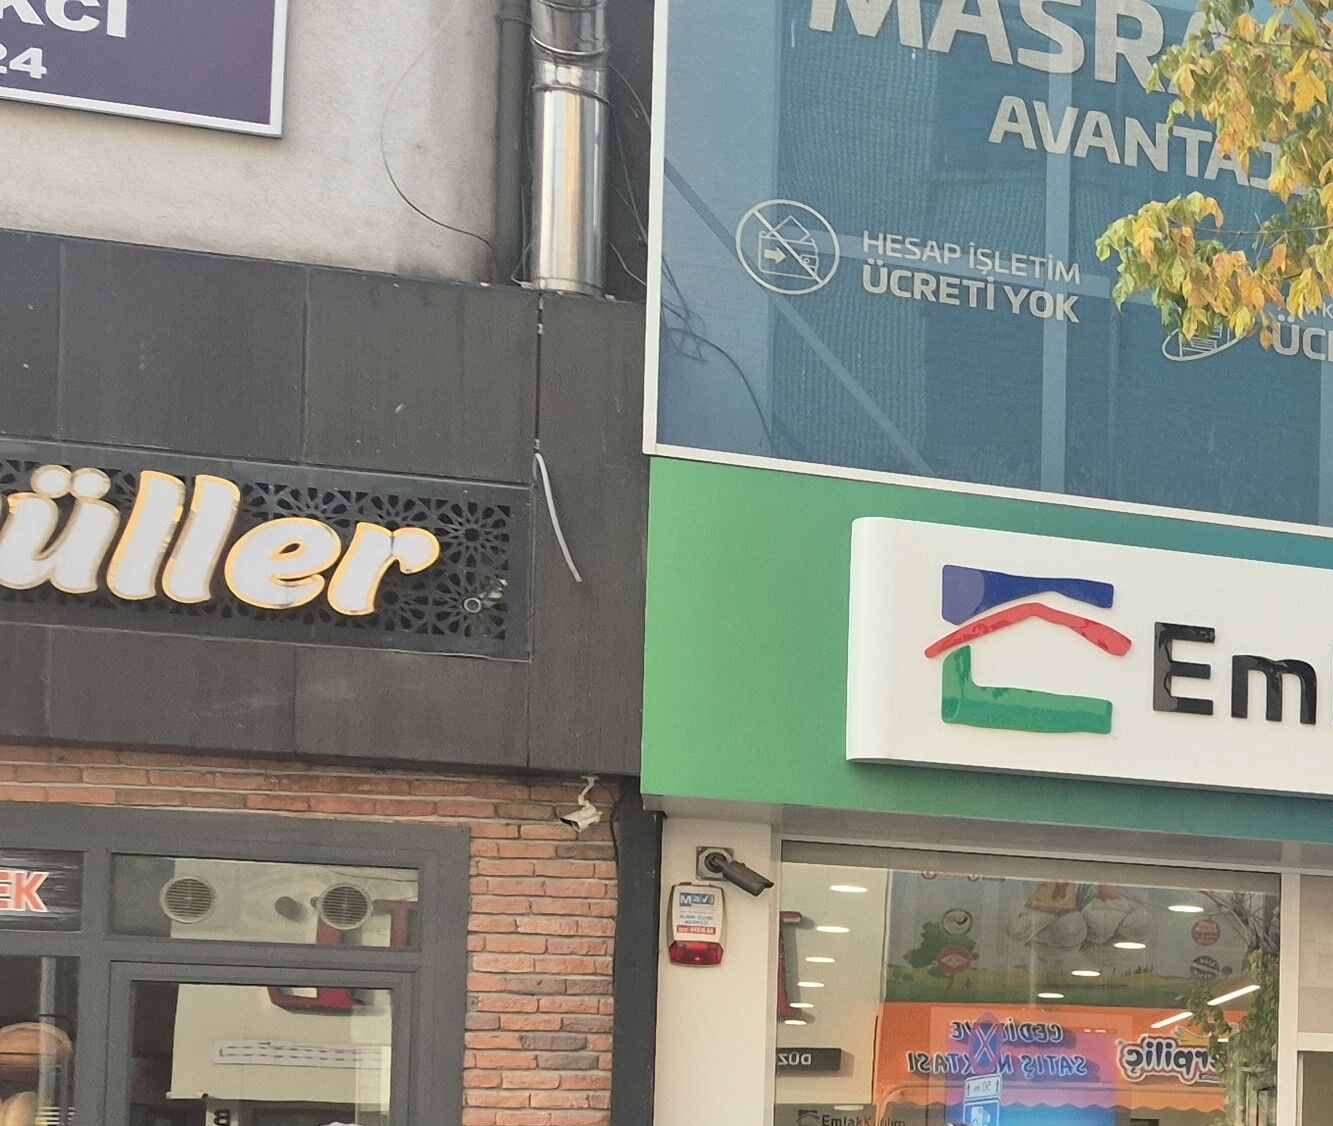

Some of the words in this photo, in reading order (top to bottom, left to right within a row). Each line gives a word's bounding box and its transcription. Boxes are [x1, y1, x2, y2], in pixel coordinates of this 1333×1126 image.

[0, 43, 47, 79] 4
[862, 230, 960, 265] HESAP
[969, 244, 1080, 285] İŞLETİM
[862, 257, 995, 311] ÜCRETİ
[1008, 290, 1080, 324] YOK
